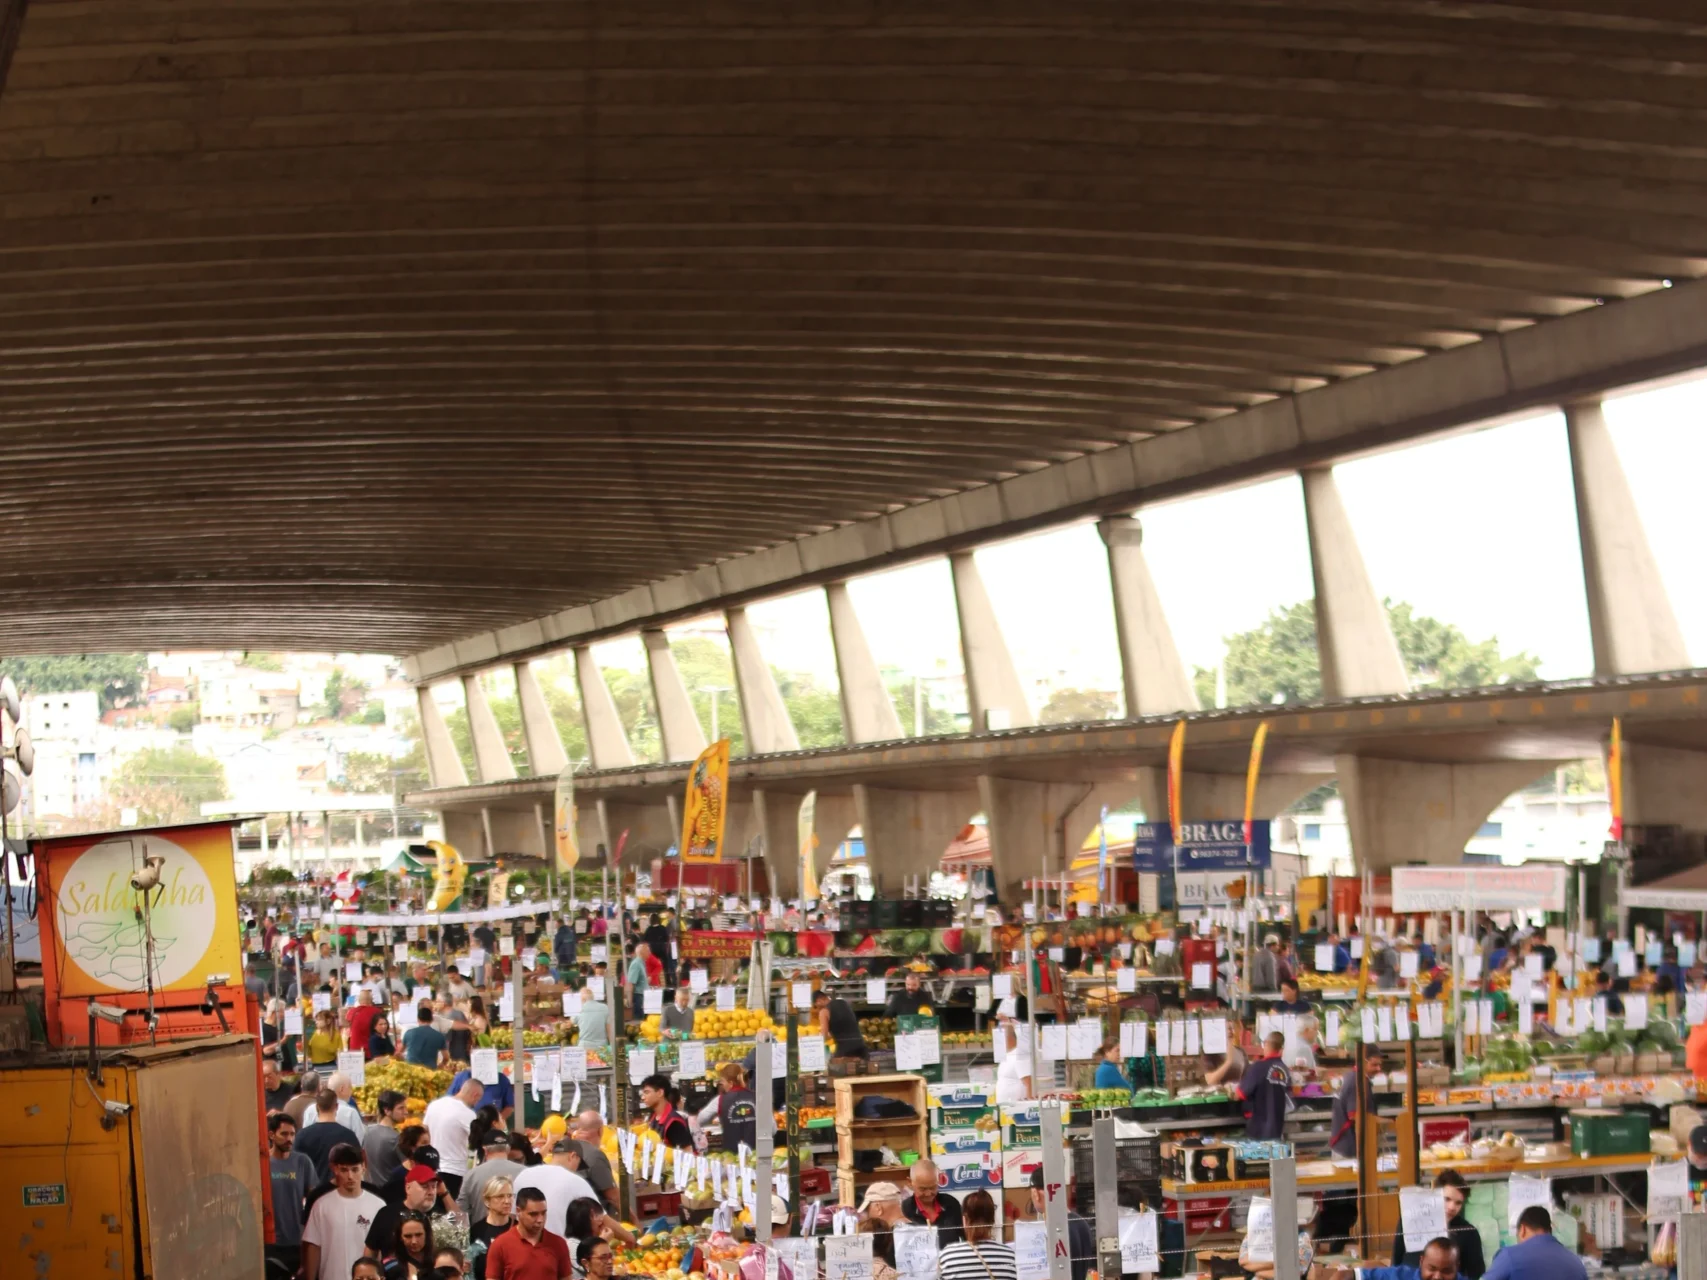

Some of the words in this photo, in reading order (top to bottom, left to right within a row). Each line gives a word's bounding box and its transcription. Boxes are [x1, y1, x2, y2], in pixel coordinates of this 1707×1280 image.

[59, 866, 205, 917] Saldnha
[1184, 884, 1228, 898] BRA
[699, 939, 726, 947] REI
[680, 949, 752, 957] MELANCI
[943, 1116, 970, 1126] Pears
[1016, 1133, 1041, 1143] Pears
